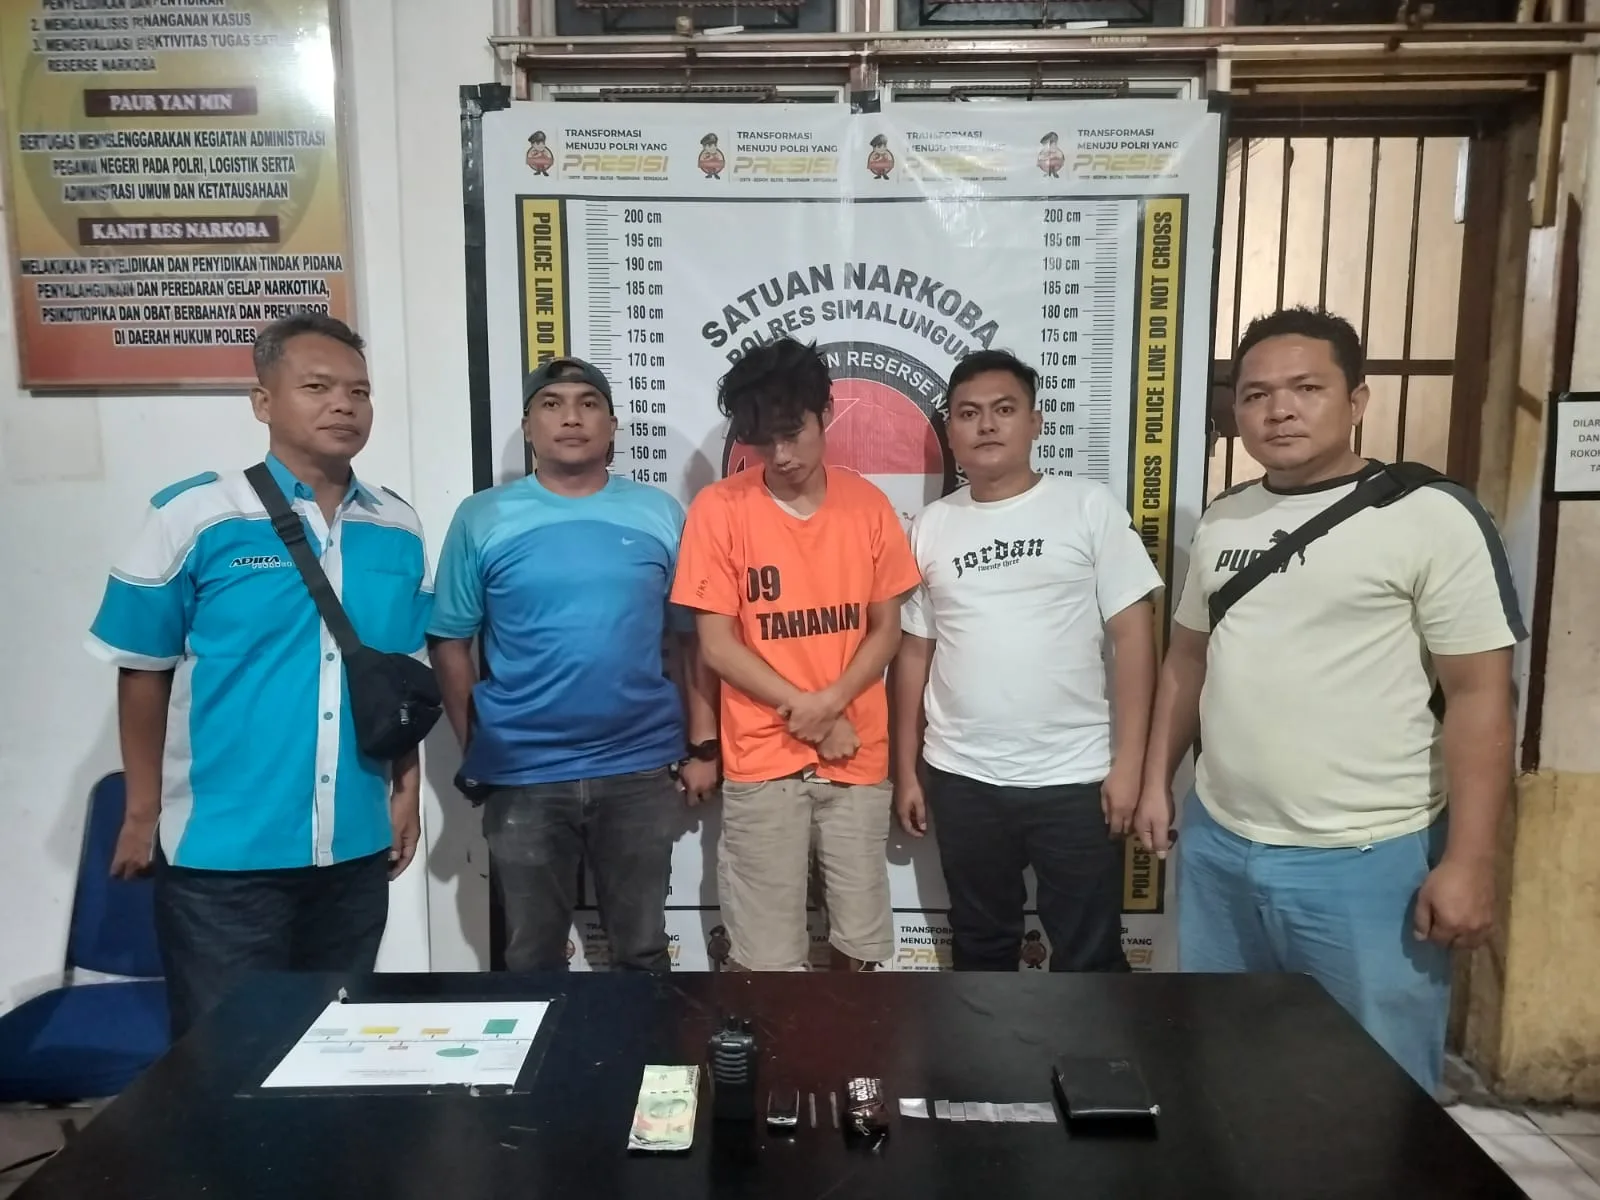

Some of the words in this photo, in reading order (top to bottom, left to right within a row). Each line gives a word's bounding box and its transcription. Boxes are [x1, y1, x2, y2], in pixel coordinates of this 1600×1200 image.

[212, 13, 251, 26] KASUS
[211, 34, 250, 47] TUGAS
[48, 59, 98, 71] RESERSE
[102, 58, 156, 71] NARKOBA
[109, 94, 157, 111] PAUR
[159, 94, 196, 110] YAN
[199, 94, 233, 110] MIN
[565, 129, 642, 138] TRANSFORMASI
[736, 131, 813, 140] TRANSFORMASI
[1077, 128, 1155, 137] TRANSFORMASI
[19, 134, 75, 150] BERTUGAS
[78, 131, 191, 149] MENYELENGGARAKAN
[194, 131, 247, 147] KEGIATAN
[250, 130, 325, 147] ADMINISTRASI
[565, 142, 606, 150] MENUJU
[609, 142, 638, 151] POLRI
[640, 143, 668, 151] YANG
[1077, 141, 1118, 150] MENUJU
[1120, 141, 1150, 150] POLRI
[1152, 141, 1179, 149] YANG
[737, 144, 778, 153] MENUJU
[780, 144, 809, 153] POLRI
[811, 144, 838, 153] YANG
[100, 157, 139, 174] NEGERI
[142, 157, 170, 174] PADA
[172, 157, 207, 177] POLRI,
[210, 156, 259, 173] LOGISTIK
[262, 156, 296, 172] SERTA
[562, 154, 669, 173] PRESISI
[733, 156, 839, 174] PRESISI
[1072, 153, 1176, 171] PRESIS
[138, 183, 171, 199] UMUM
[173, 183, 195, 199] DAN
[198, 182, 288, 199] KETATAUSAHAAN
[624, 209, 644, 223] 200
[647, 212, 662, 223] cm
[1044, 208, 1063, 223] 200
[1066, 211, 1081, 223] cm
[91, 223, 148, 239] KANIT
[149, 223, 183, 239] RES
[186, 222, 270, 238] NARKOBA
[533, 212, 553, 272] POLICE
[625, 233, 644, 247] 195
[647, 236, 662, 247] cm
[1043, 233, 1062, 247] 195
[1065, 235, 1080, 247] cm
[1152, 211, 1172, 270] CROSS
[20, 259, 87, 275] MELAKUKAN
[90, 257, 165, 274] PENYELIDIKAN
[167, 257, 190, 272] DAN
[192, 256, 257, 272] PENYIDIKAN
[260, 256, 300, 271] TINDAK
[303, 255, 343, 271] PIDANA
[625, 257, 644, 271] 190
[648, 260, 663, 271] cm
[1043, 257, 1062, 271] 190
[1065, 259, 1080, 271] cm
[37, 283, 134, 298] PENYALAHGUNAAN
[137, 281, 159, 297] DAN
[161, 281, 224, 297] PEREDARAN
[227, 280, 261, 295] GELAP
[264, 279, 330, 298] NARKOTIKA,
[626, 281, 645, 295] 185
[648, 284, 663, 295] cm
[1043, 281, 1061, 295] 185
[1064, 283, 1079, 295] cm
[1150, 275, 1169, 309] NOT
[535, 277, 554, 316] LINE
[42, 306, 117, 322] PSIKOTROPIKA
[119, 306, 141, 321] DAN
[143, 306, 171, 321] OBAT
[174, 305, 237, 320] BERBAHAYA
[239, 304, 261, 320] DAN
[627, 305, 646, 319] 180
[649, 308, 664, 319] cm
[701, 263, 834, 348] SATUAN
[844, 262, 1000, 350] NARKOBA
[1041, 304, 1060, 318] 180
[1063, 306, 1078, 318] cm
[537, 321, 555, 344] DO
[1149, 315, 1168, 339] DO
[115, 330, 125, 345] DI
[128, 329, 170, 345] DAERAH
[173, 329, 212, 344] HUKUM
[215, 328, 256, 343] POLRES
[628, 329, 646, 343] 175
[650, 332, 664, 343] cm
[726, 305, 816, 366] POLRES
[1041, 328, 1059, 342] 175
[1063, 331, 1077, 342] cm
[628, 353, 647, 367] 170
[650, 356, 665, 367] cm
[1040, 352, 1059, 366] 170
[1062, 354, 1077, 366] cm
[1147, 344, 1166, 381] LINE
[847, 351, 934, 396] RESERSE
[629, 376, 647, 390] 165
[651, 379, 665, 390] cm
[1039, 376, 1058, 389] 165
[1061, 377, 1075, 389] cm
[629, 400, 648, 413] 160
[651, 402, 666, 413] cm
[1038, 399, 1057, 412] 160
[1060, 401, 1075, 412] cm
[1145, 387, 1164, 444] POLICE
[630, 423, 648, 436] 155
[652, 425, 666, 436] cm
[1060, 424, 1074, 435] cm
[1579, 434, 1599, 443] DAN
[631, 446, 649, 459] 150
[652, 448, 667, 459] cm
[1037, 445, 1055, 458] 150
[1058, 447, 1073, 458] cm
[631, 469, 650, 482] 145
[653, 471, 667, 482] cm
[1142, 455, 1162, 510] CROSS
[1142, 515, 1160, 548] NOT
[1214, 549, 1288, 574] PU
[746, 565, 781, 603] 09
[900, 937, 938, 945] MENUJU
